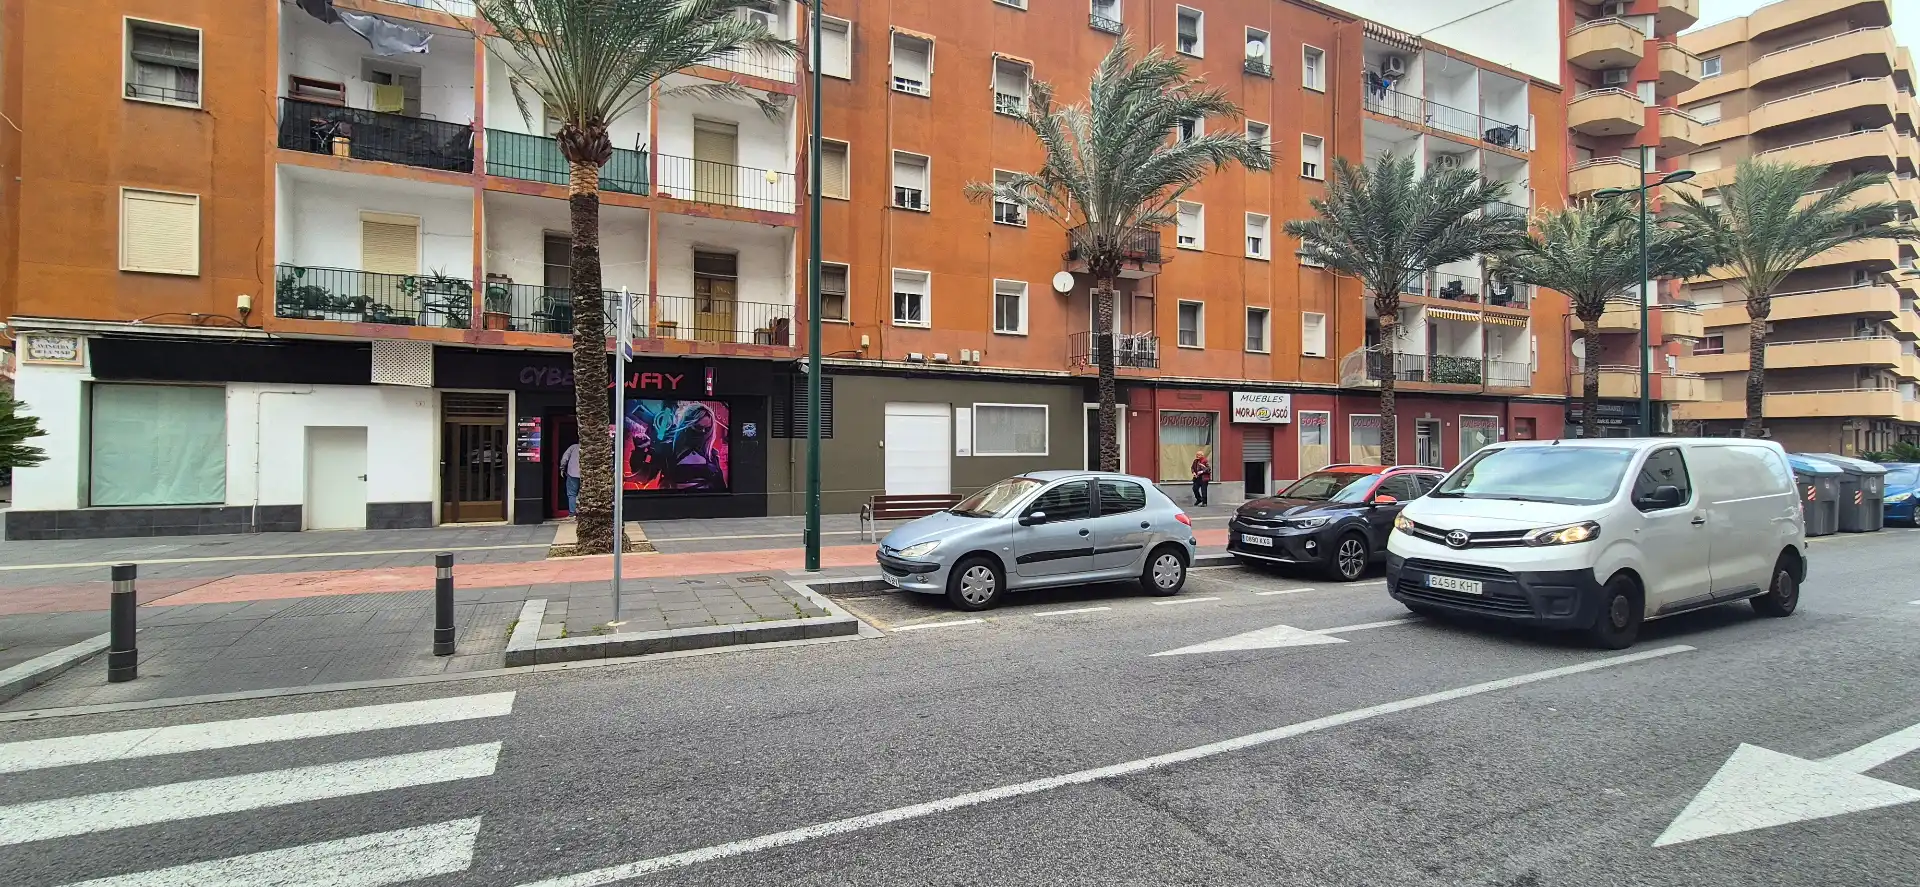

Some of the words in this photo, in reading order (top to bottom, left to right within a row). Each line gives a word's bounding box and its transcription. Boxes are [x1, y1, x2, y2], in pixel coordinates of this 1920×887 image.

[519, 366, 574, 387] CYBE
[1240, 394, 1284, 403] MUEBLES
[1235, 407, 1256, 418] MORA
[1272, 406, 1288, 419] ASCÓ
[1431, 576, 1456, 588] 6458
[1459, 580, 1480, 593] KHT
